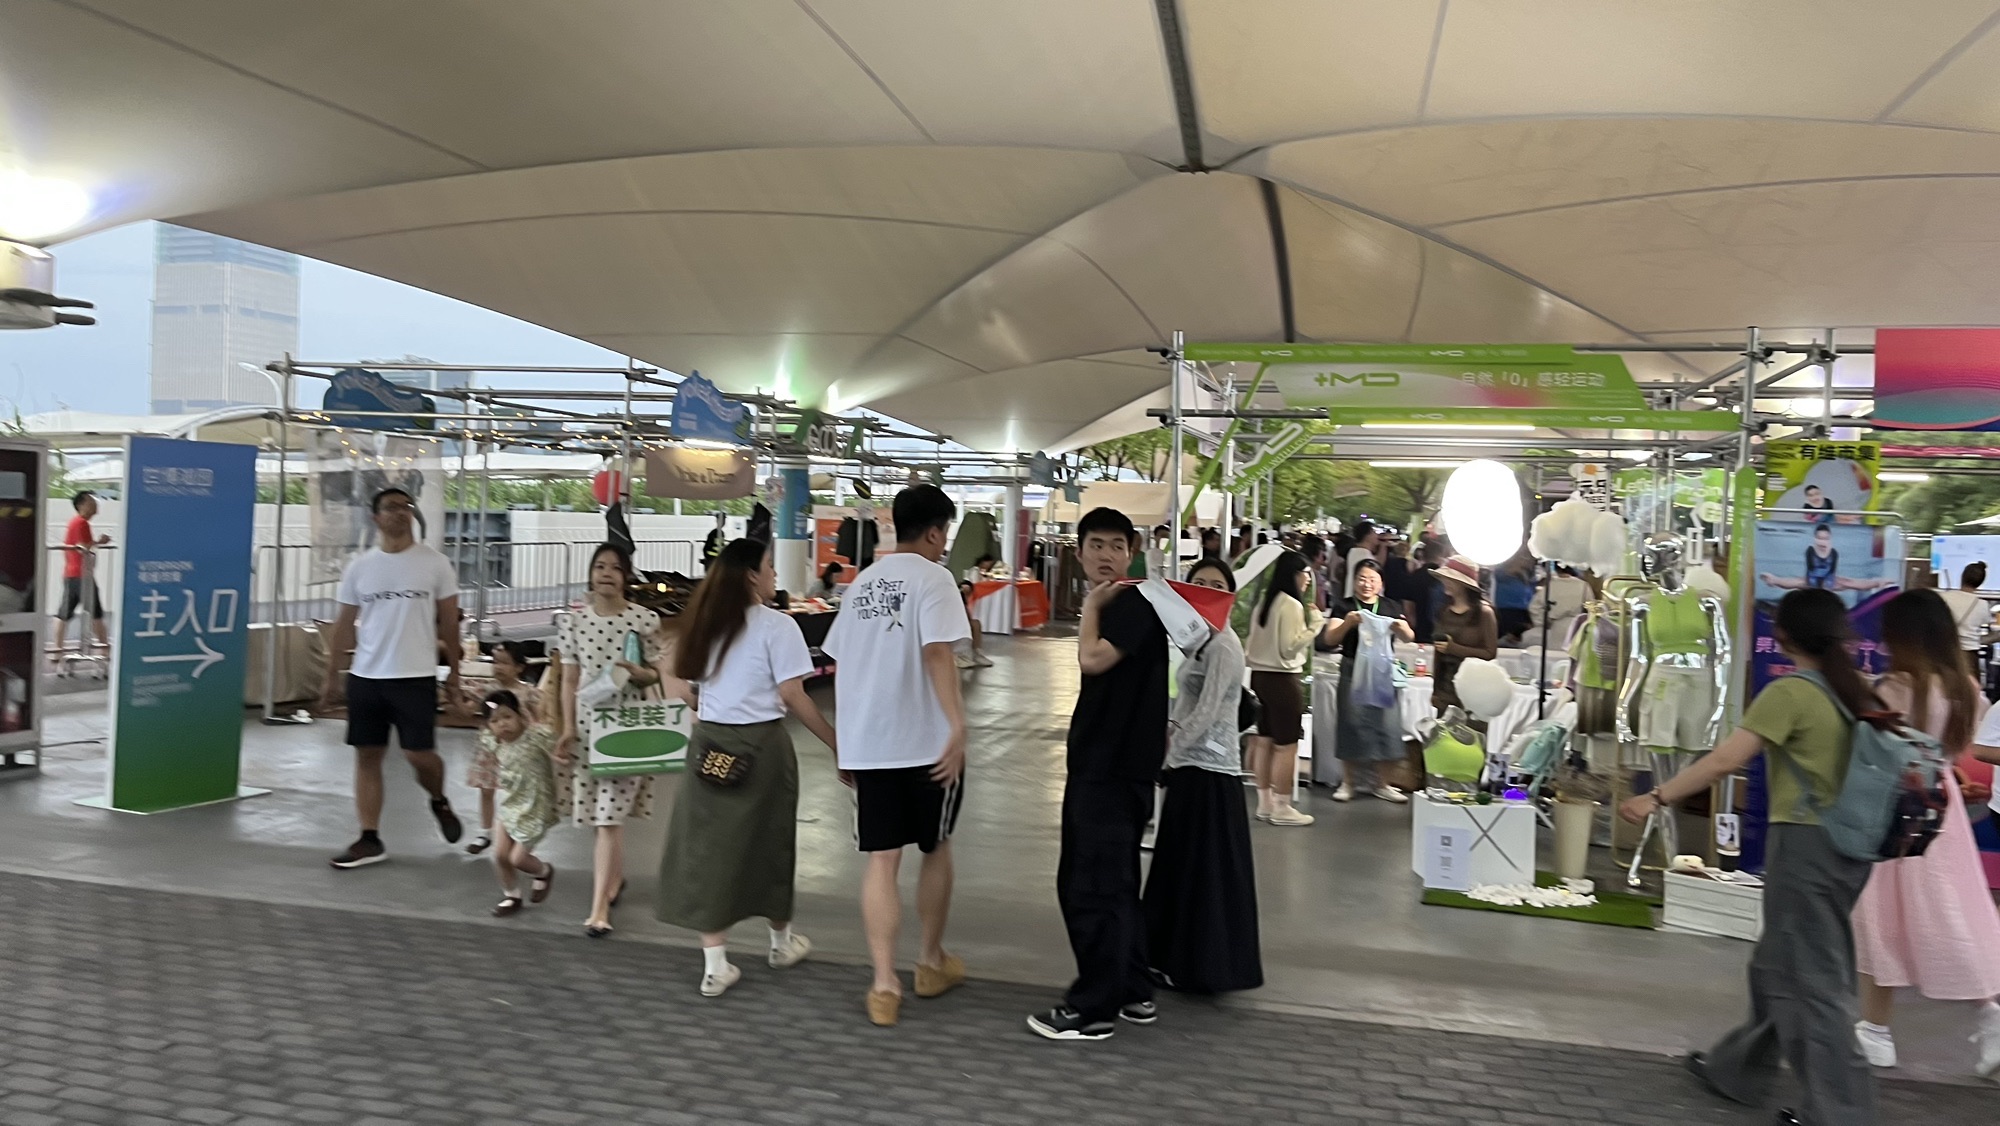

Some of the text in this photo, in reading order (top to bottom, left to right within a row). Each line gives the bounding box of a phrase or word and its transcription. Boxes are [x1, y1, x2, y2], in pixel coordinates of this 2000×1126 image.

[134, 589, 239, 637] 主入口
[594, 703, 688, 728] 不想装了
